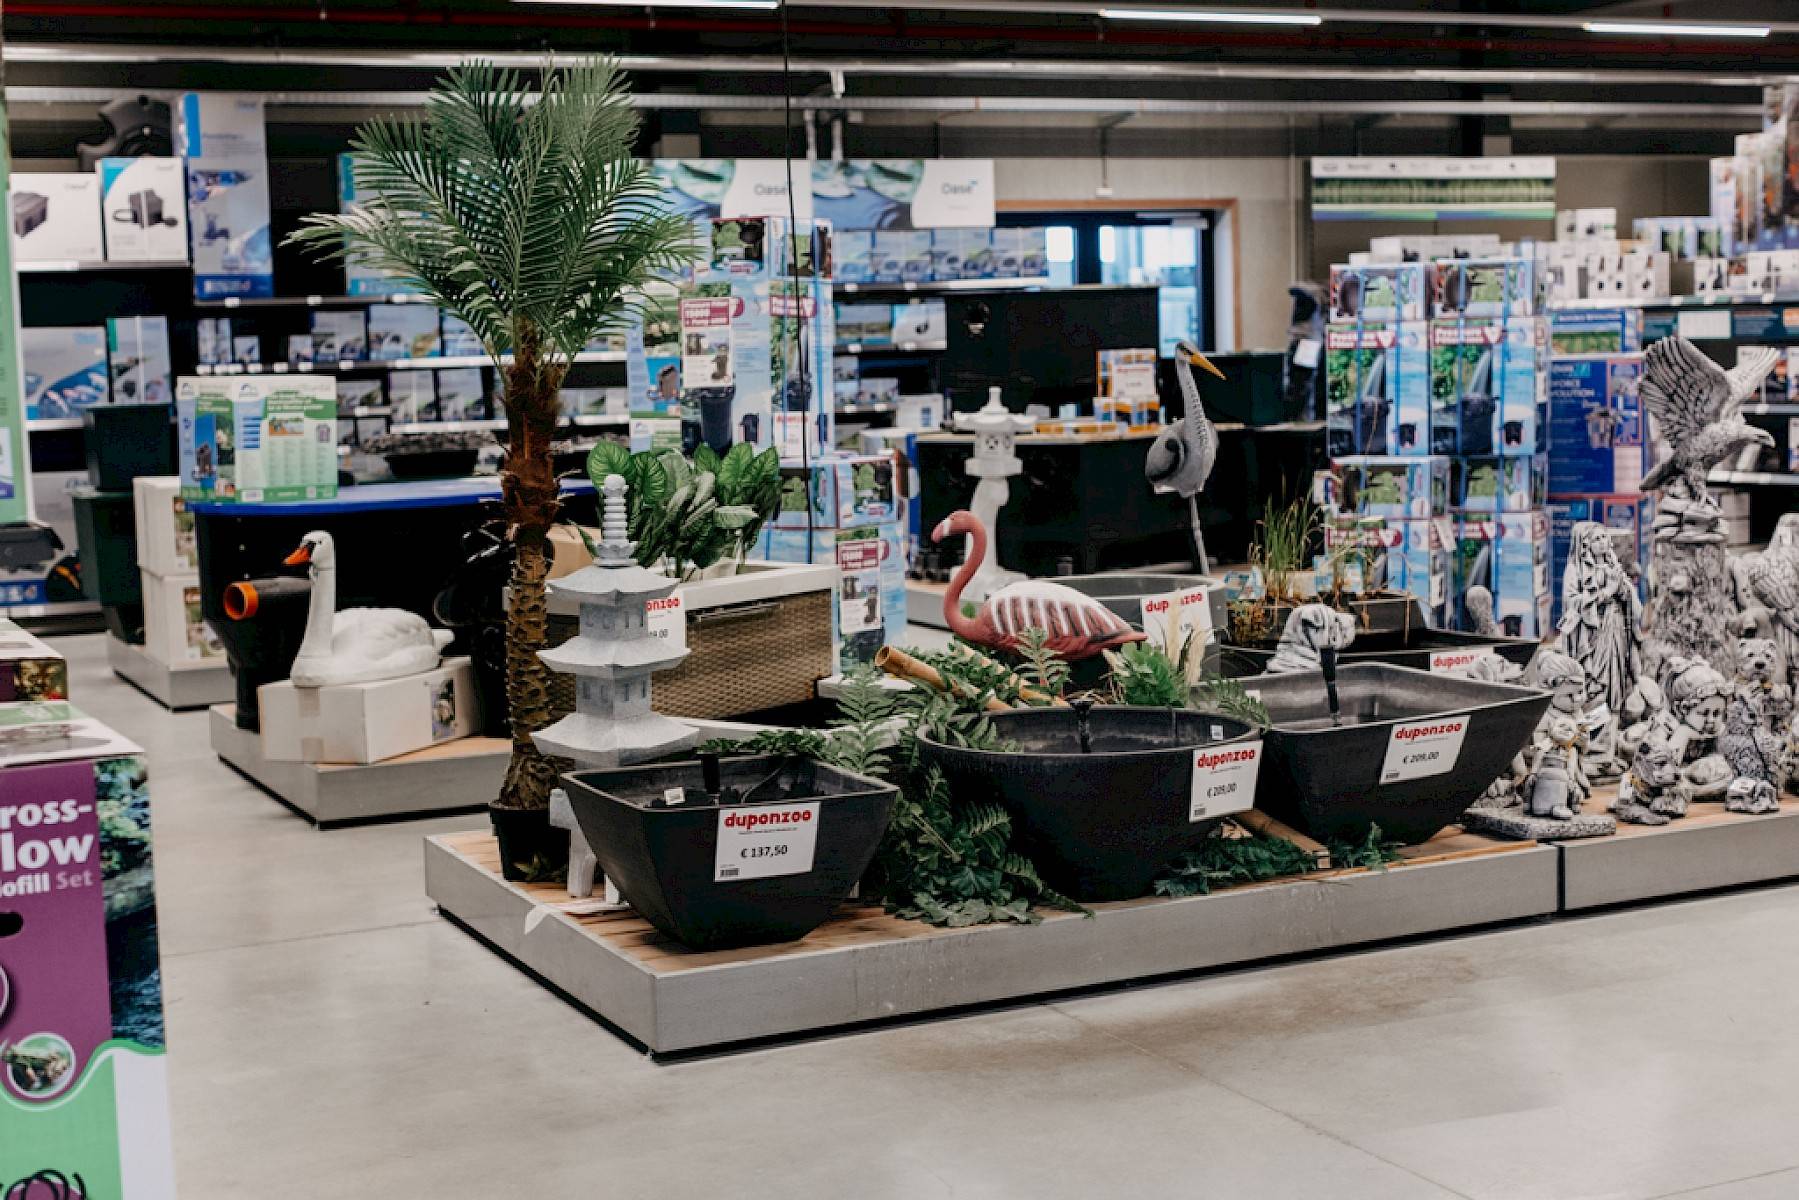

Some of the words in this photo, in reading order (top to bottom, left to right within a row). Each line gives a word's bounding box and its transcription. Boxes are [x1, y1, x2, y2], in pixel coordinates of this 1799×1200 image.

[645, 597, 680, 611] onzoo
[1145, 592, 1203, 613] dupzoo
[1434, 655, 1475, 671] dupon
[1395, 723, 1462, 740] duponzoo
[1198, 750, 1255, 770] duponzoo
[1410, 751, 1440, 763] 209,00
[0, 799, 92, 829] ross-
[724, 809, 812, 830] duponzoo
[0, 832, 94, 872] low
[751, 845, 788, 858] 137,50
[0, 872, 51, 898] ofill
[56, 870, 93, 890] Set
